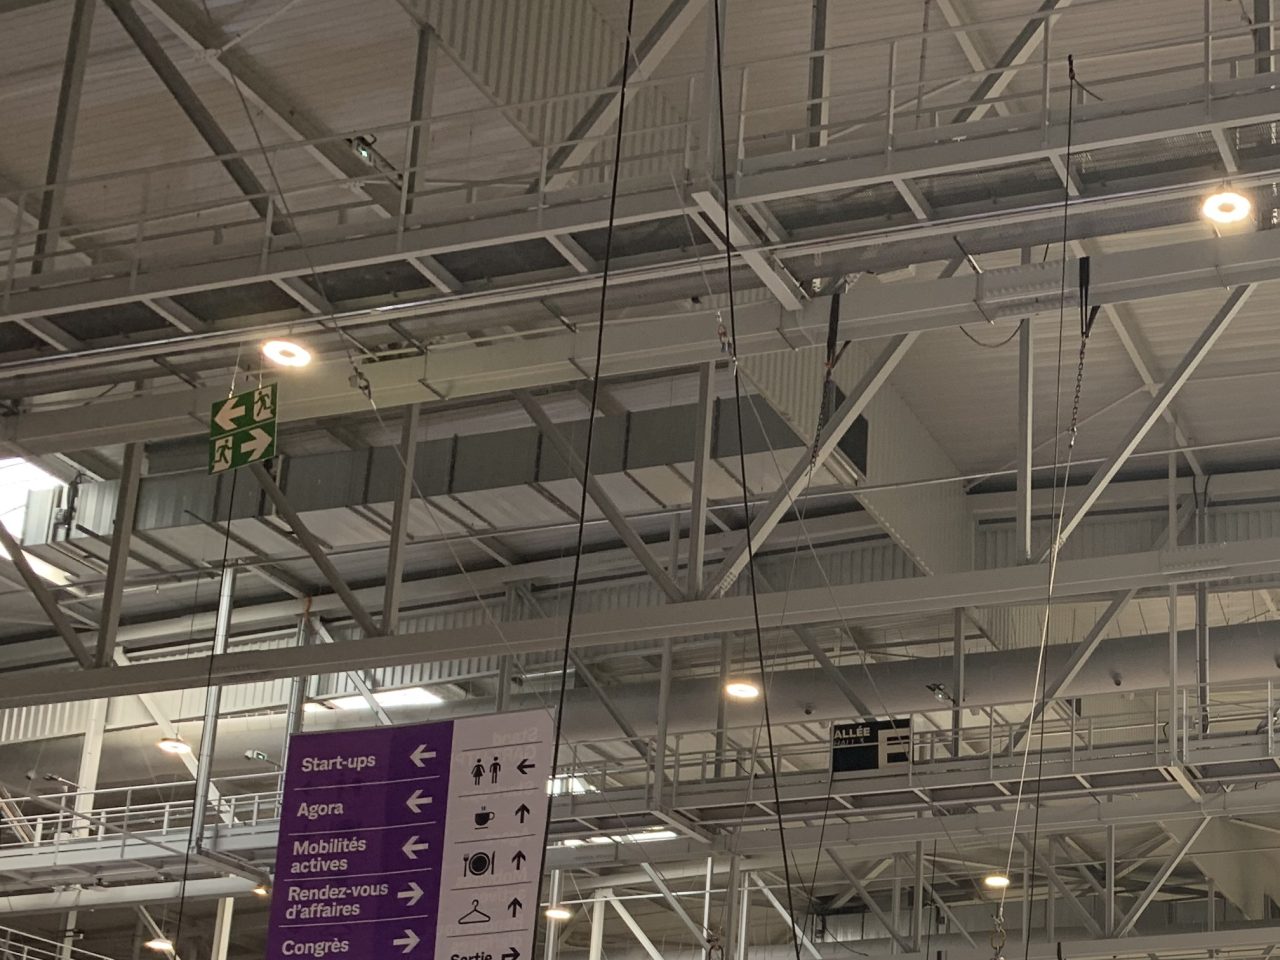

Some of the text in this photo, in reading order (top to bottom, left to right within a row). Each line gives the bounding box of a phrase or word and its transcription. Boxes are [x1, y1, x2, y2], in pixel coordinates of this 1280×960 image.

[834, 725, 870, 739] ALLÉE
[301, 754, 376, 772] Start-ups
[297, 802, 344, 820] Agora
[293, 837, 366, 856] Mobilités
[290, 858, 348, 874] actives
[288, 882, 389, 902] Rendez-vous
[286, 903, 360, 920] d'affaires
[282, 938, 349, 957] Congrès
